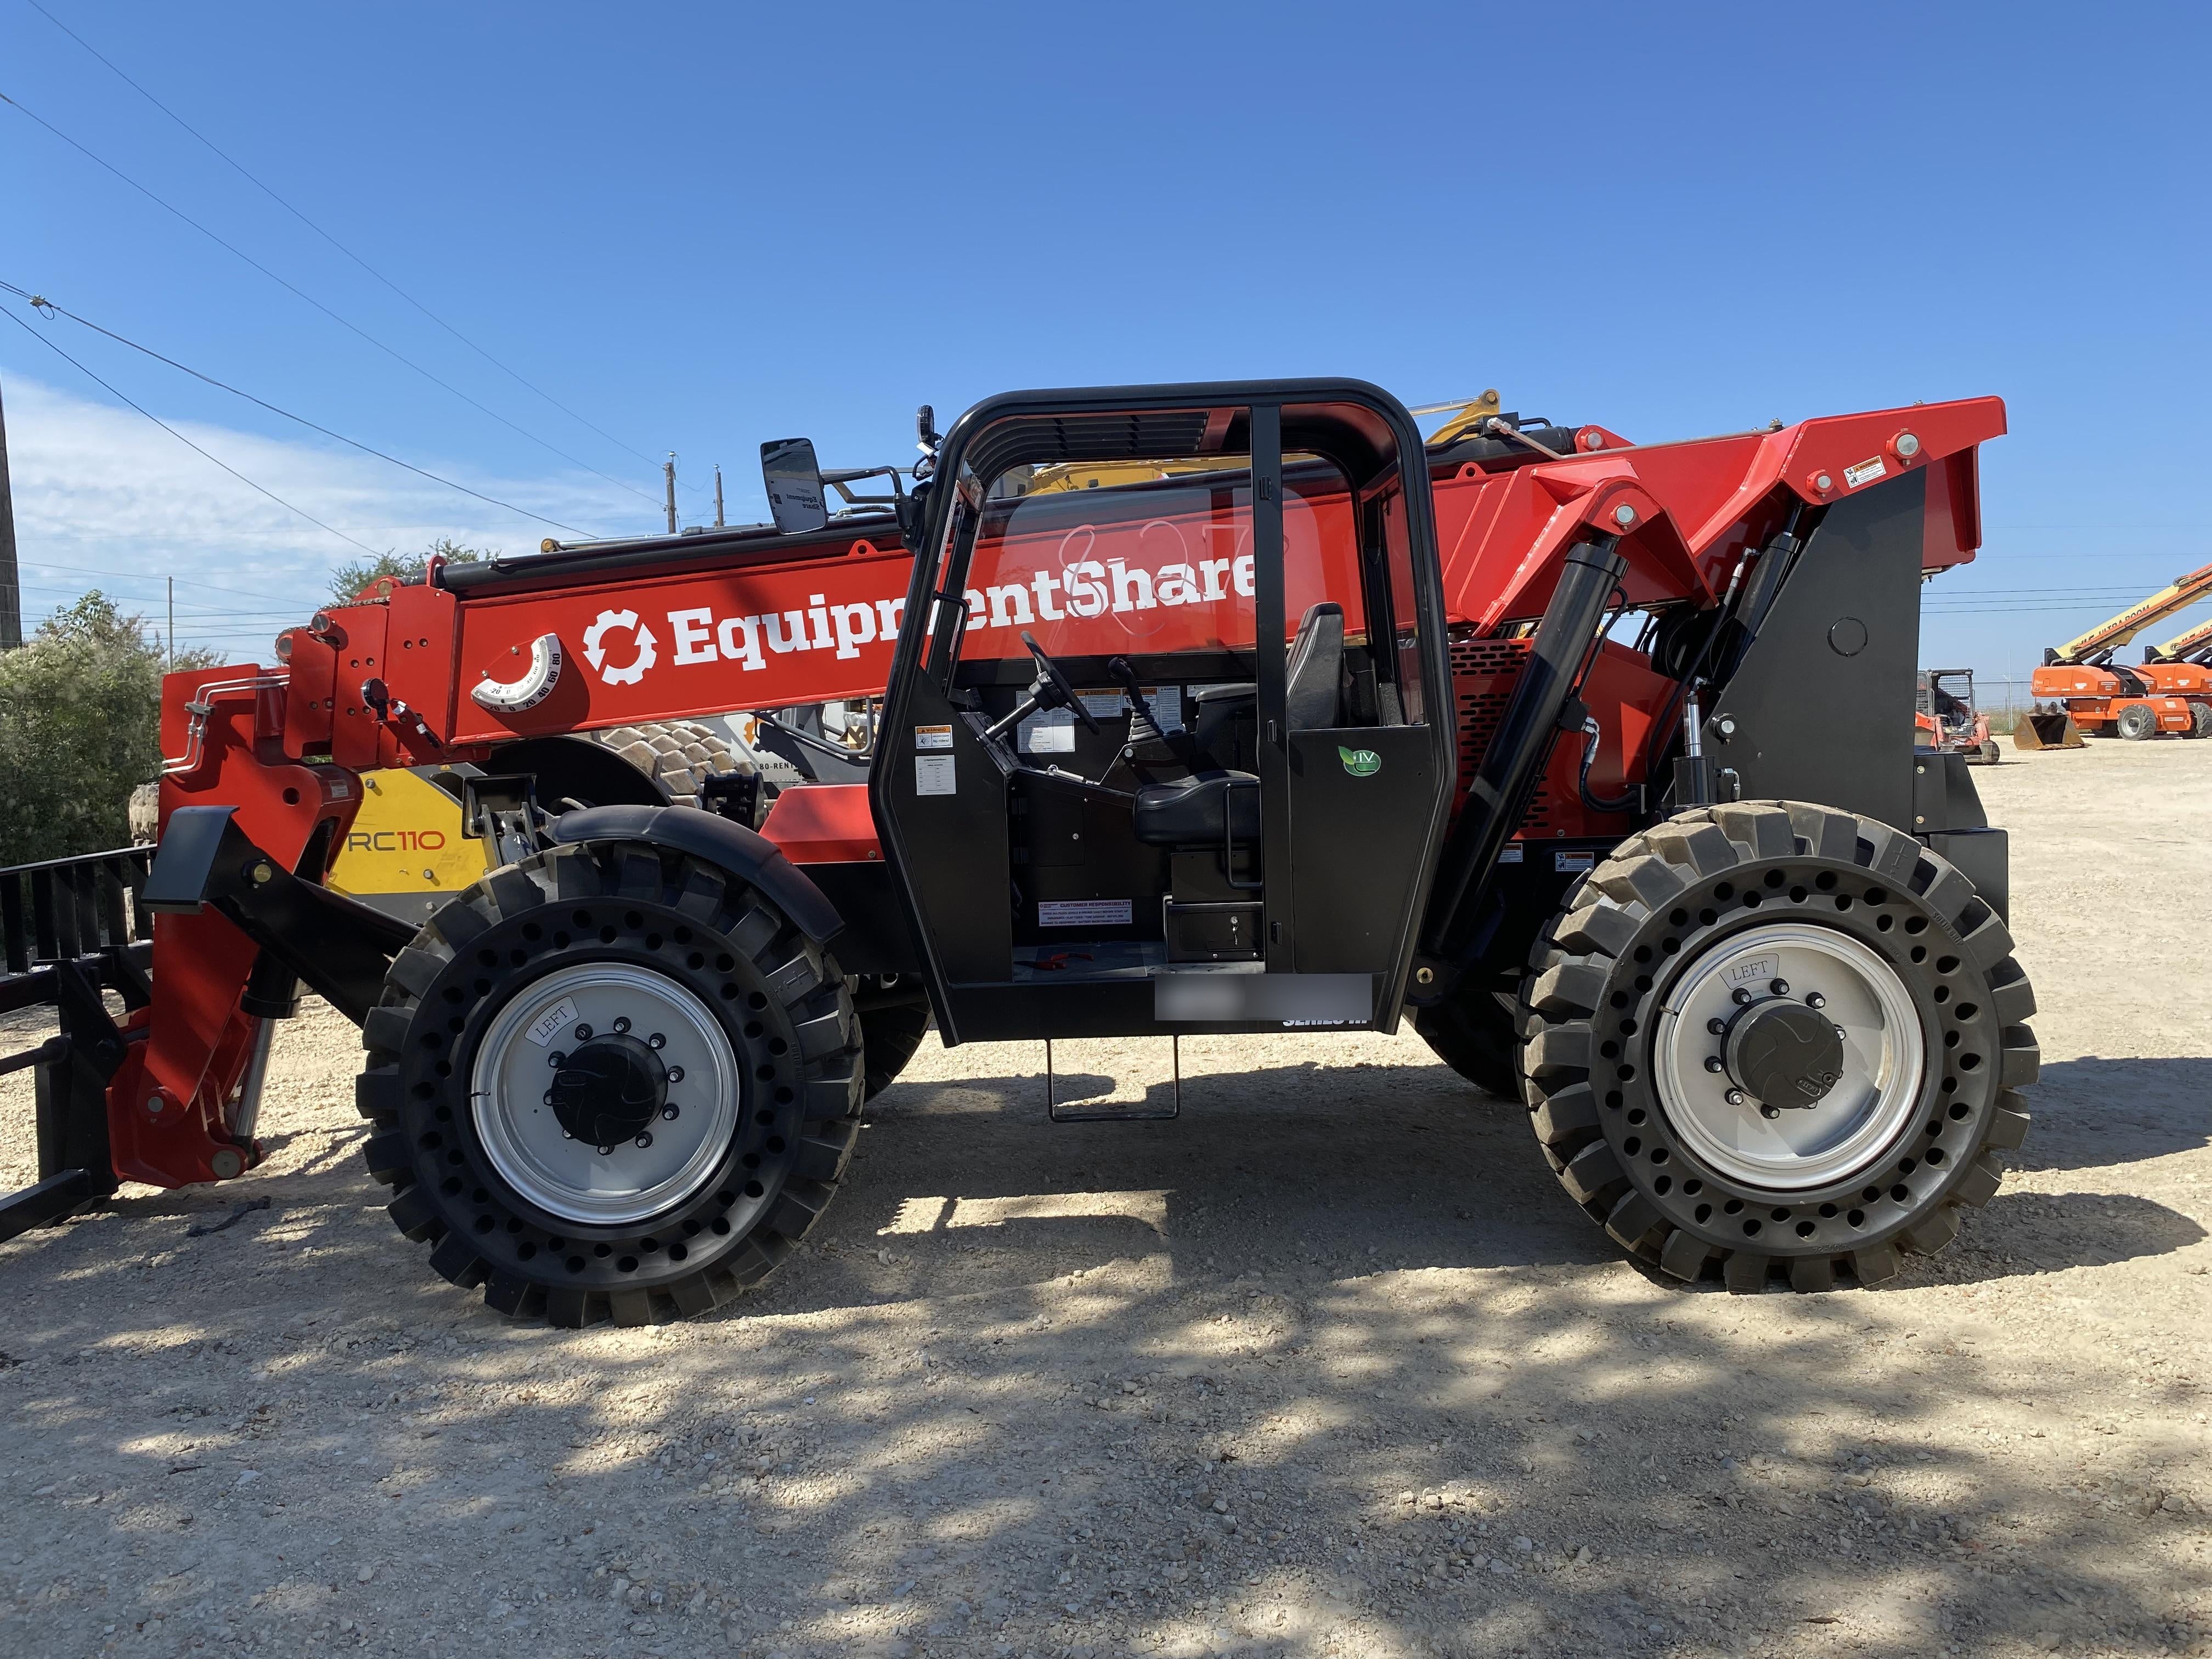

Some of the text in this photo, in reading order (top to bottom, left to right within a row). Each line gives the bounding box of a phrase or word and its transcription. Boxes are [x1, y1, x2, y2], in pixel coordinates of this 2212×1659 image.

[552, 653, 561, 665] 80
[548, 671, 558, 683] 60
[537, 687, 550, 698] 40
[523, 699, 537, 708] 20
[348, 831, 445, 851] RC110
[1731, 960, 1768, 981] LEFT
[535, 1006, 568, 1039] LEFT
